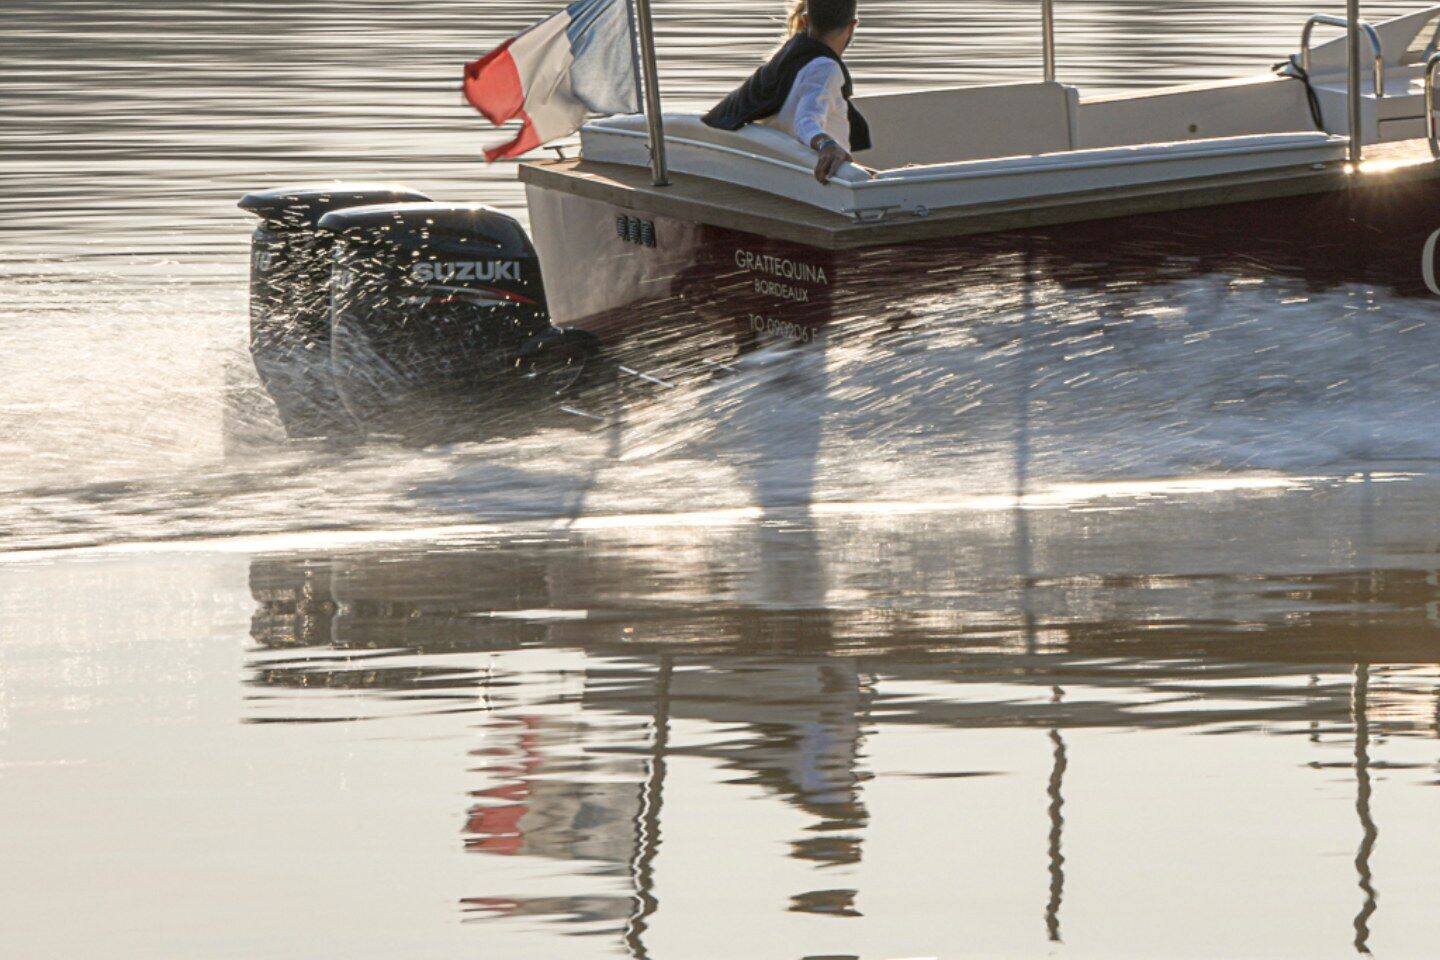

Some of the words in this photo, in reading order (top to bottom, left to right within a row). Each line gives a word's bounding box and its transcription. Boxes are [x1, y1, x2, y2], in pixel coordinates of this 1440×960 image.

[411, 259, 521, 283] SUZUKI
[734, 248, 828, 286] GRATTEQUINA
[754, 278, 810, 303] BORDEAUX
